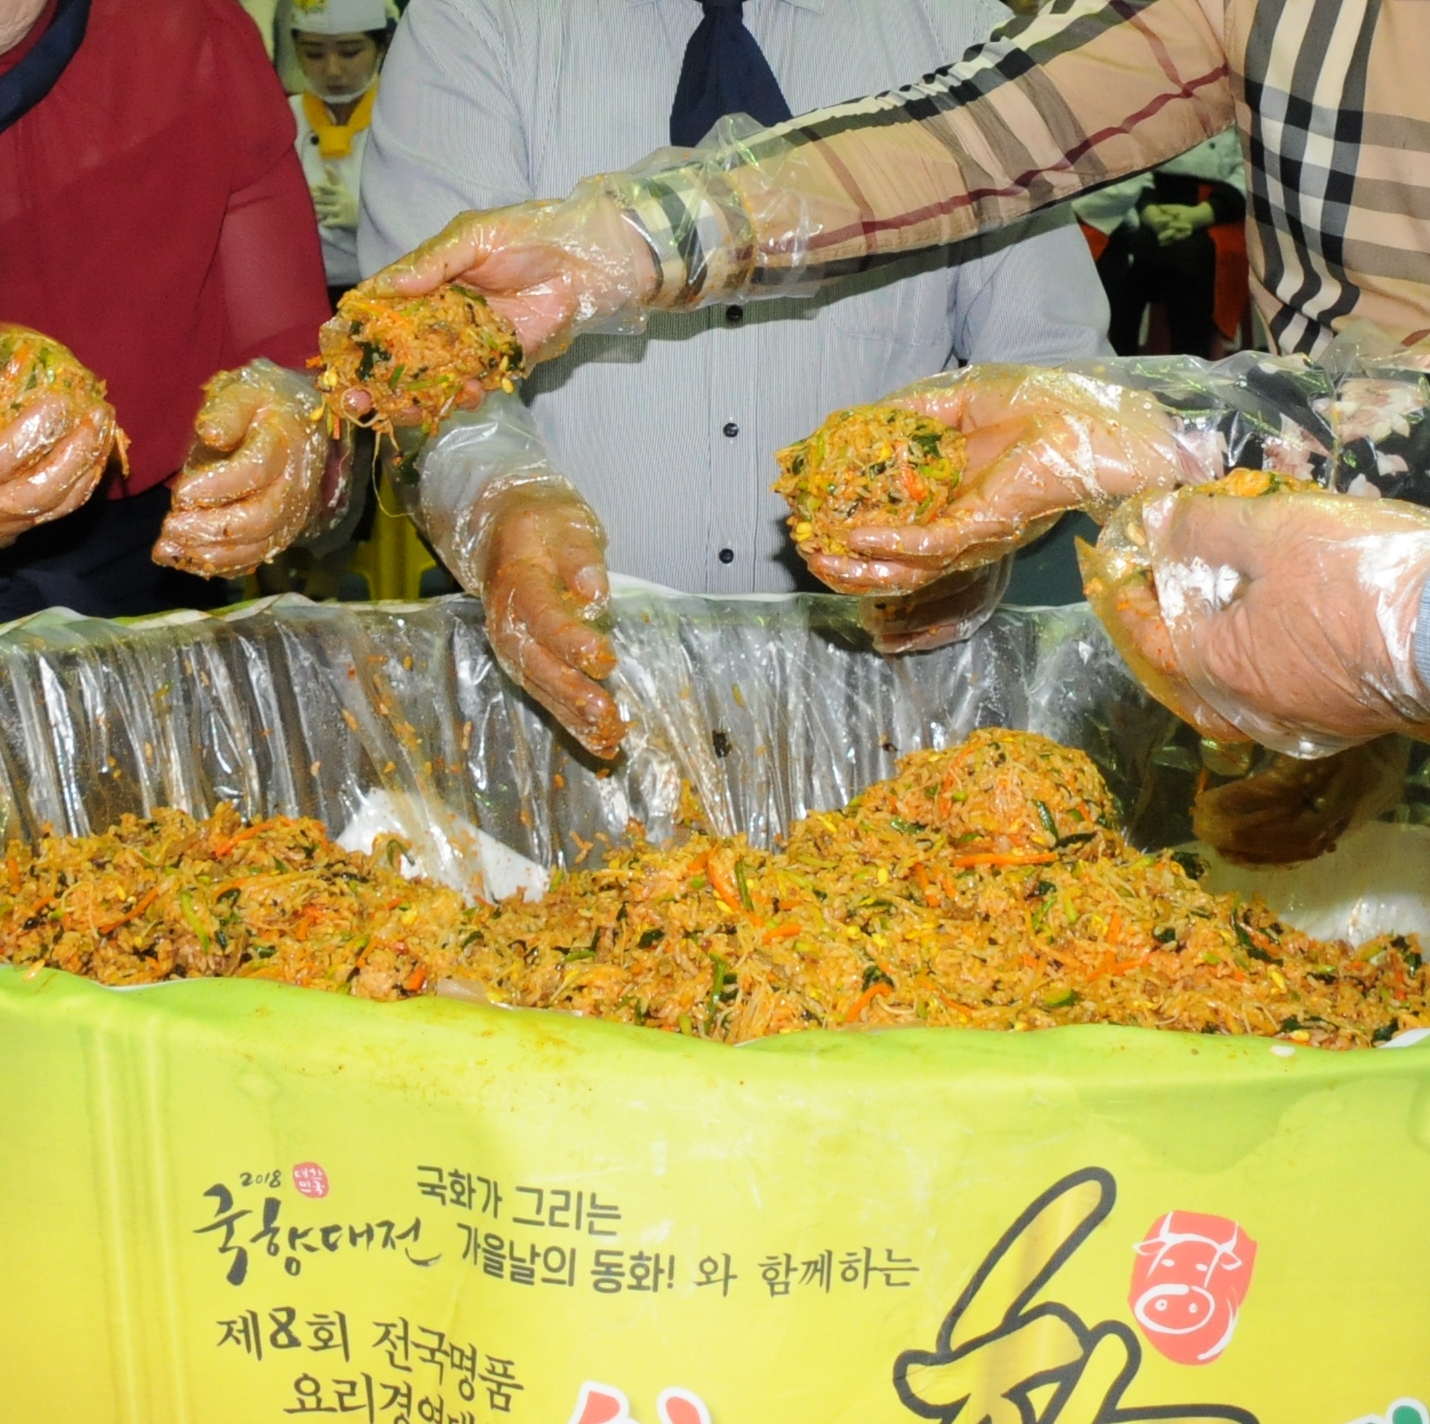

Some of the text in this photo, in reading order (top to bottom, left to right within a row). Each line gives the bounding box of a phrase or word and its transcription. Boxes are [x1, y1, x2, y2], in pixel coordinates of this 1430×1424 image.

[239, 1168, 283, 1189] 2018
[417, 1164, 622, 1236] 국화가 그리는
[192, 1183, 443, 1286] 국향대전
[457, 1222, 921, 1298] 가을날의 동화! 와 함께하는
[215, 1306, 351, 1363] 제8회
[371, 1317, 525, 1414] 전국명품
